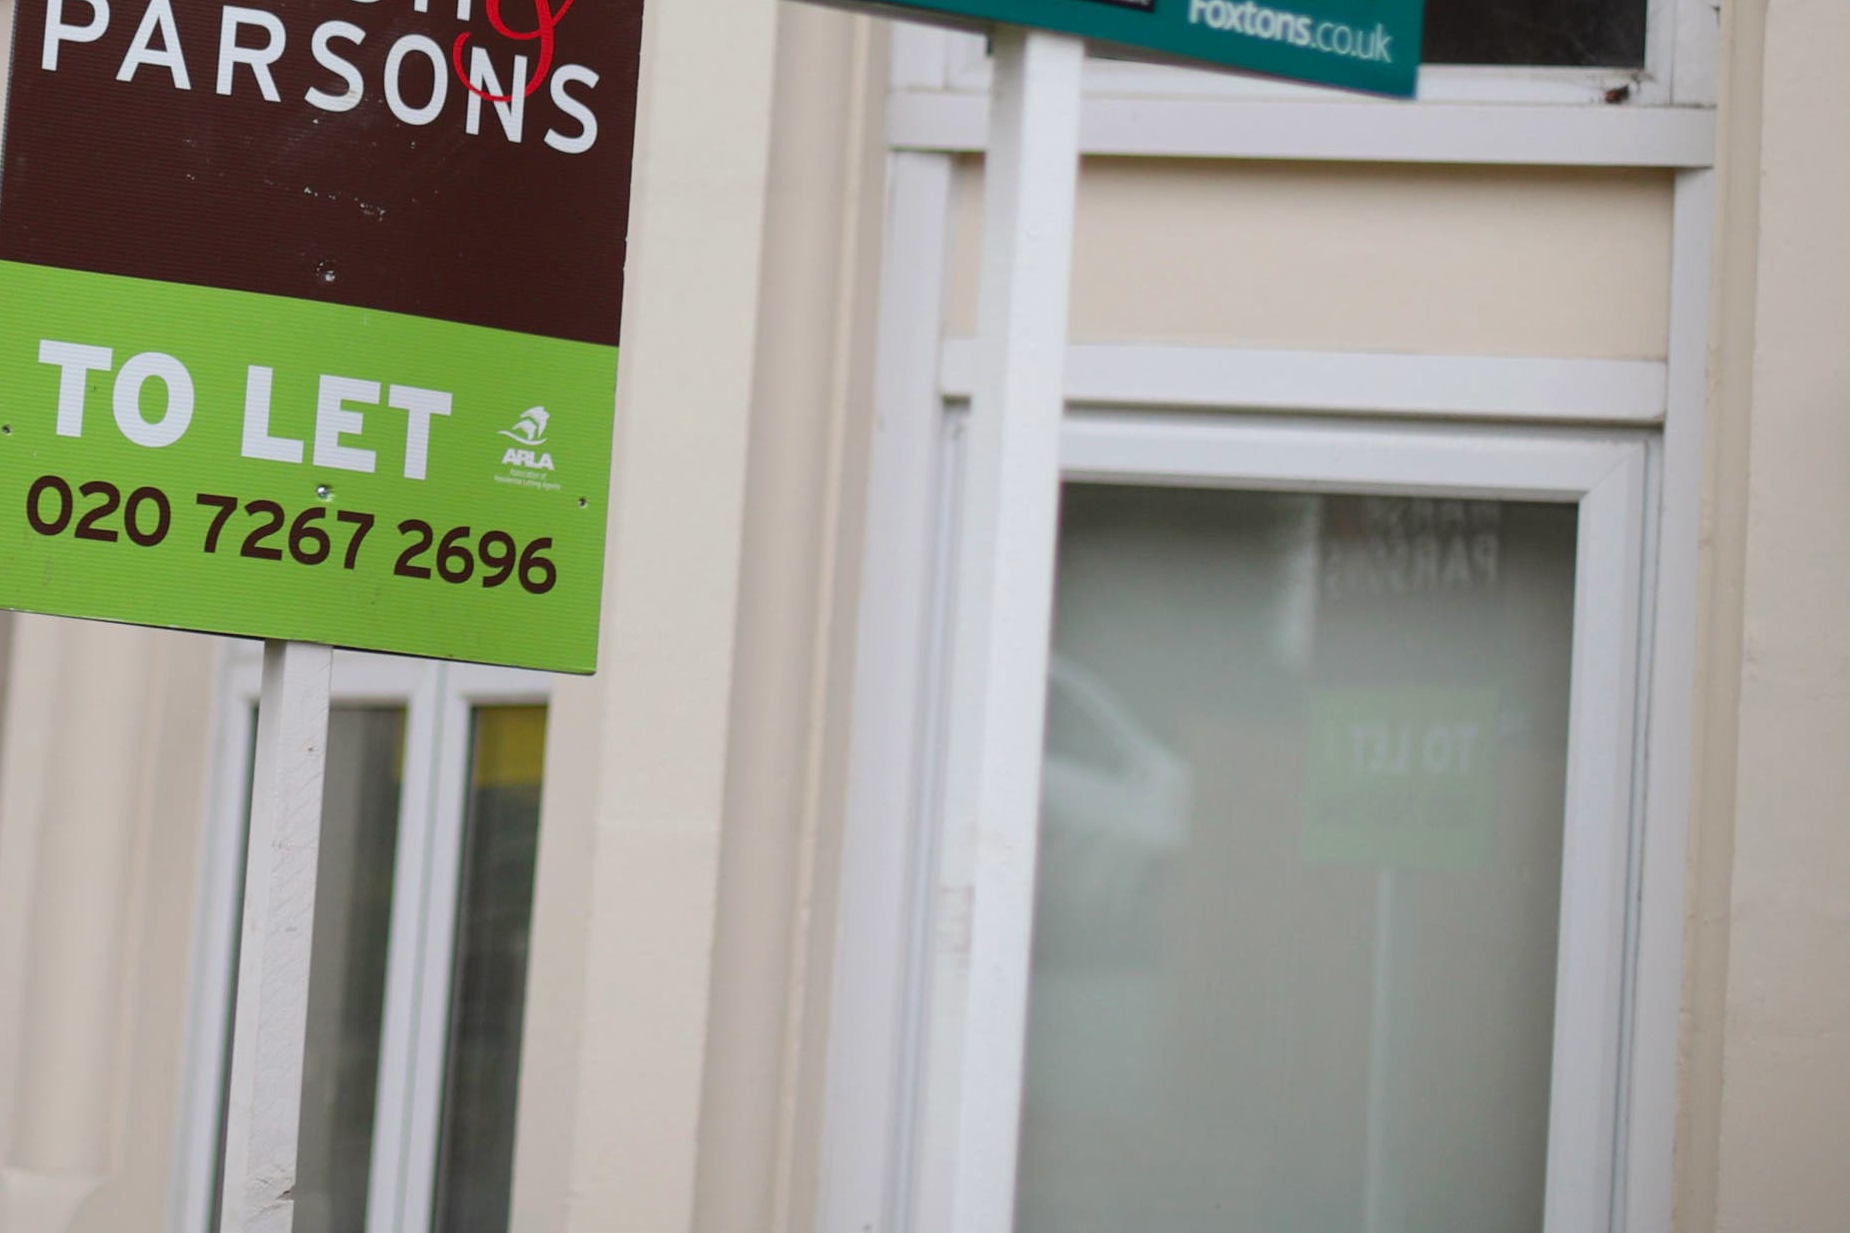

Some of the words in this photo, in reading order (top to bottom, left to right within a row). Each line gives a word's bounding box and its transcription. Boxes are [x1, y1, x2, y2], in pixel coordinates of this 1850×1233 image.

[38, 339, 195, 448] TO
[240, 365, 453, 481] LET
[501, 448, 555, 471] ARLA
[26, 475, 172, 548] 020
[195, 496, 375, 571] 7267
[393, 520, 557, 595] 2696
